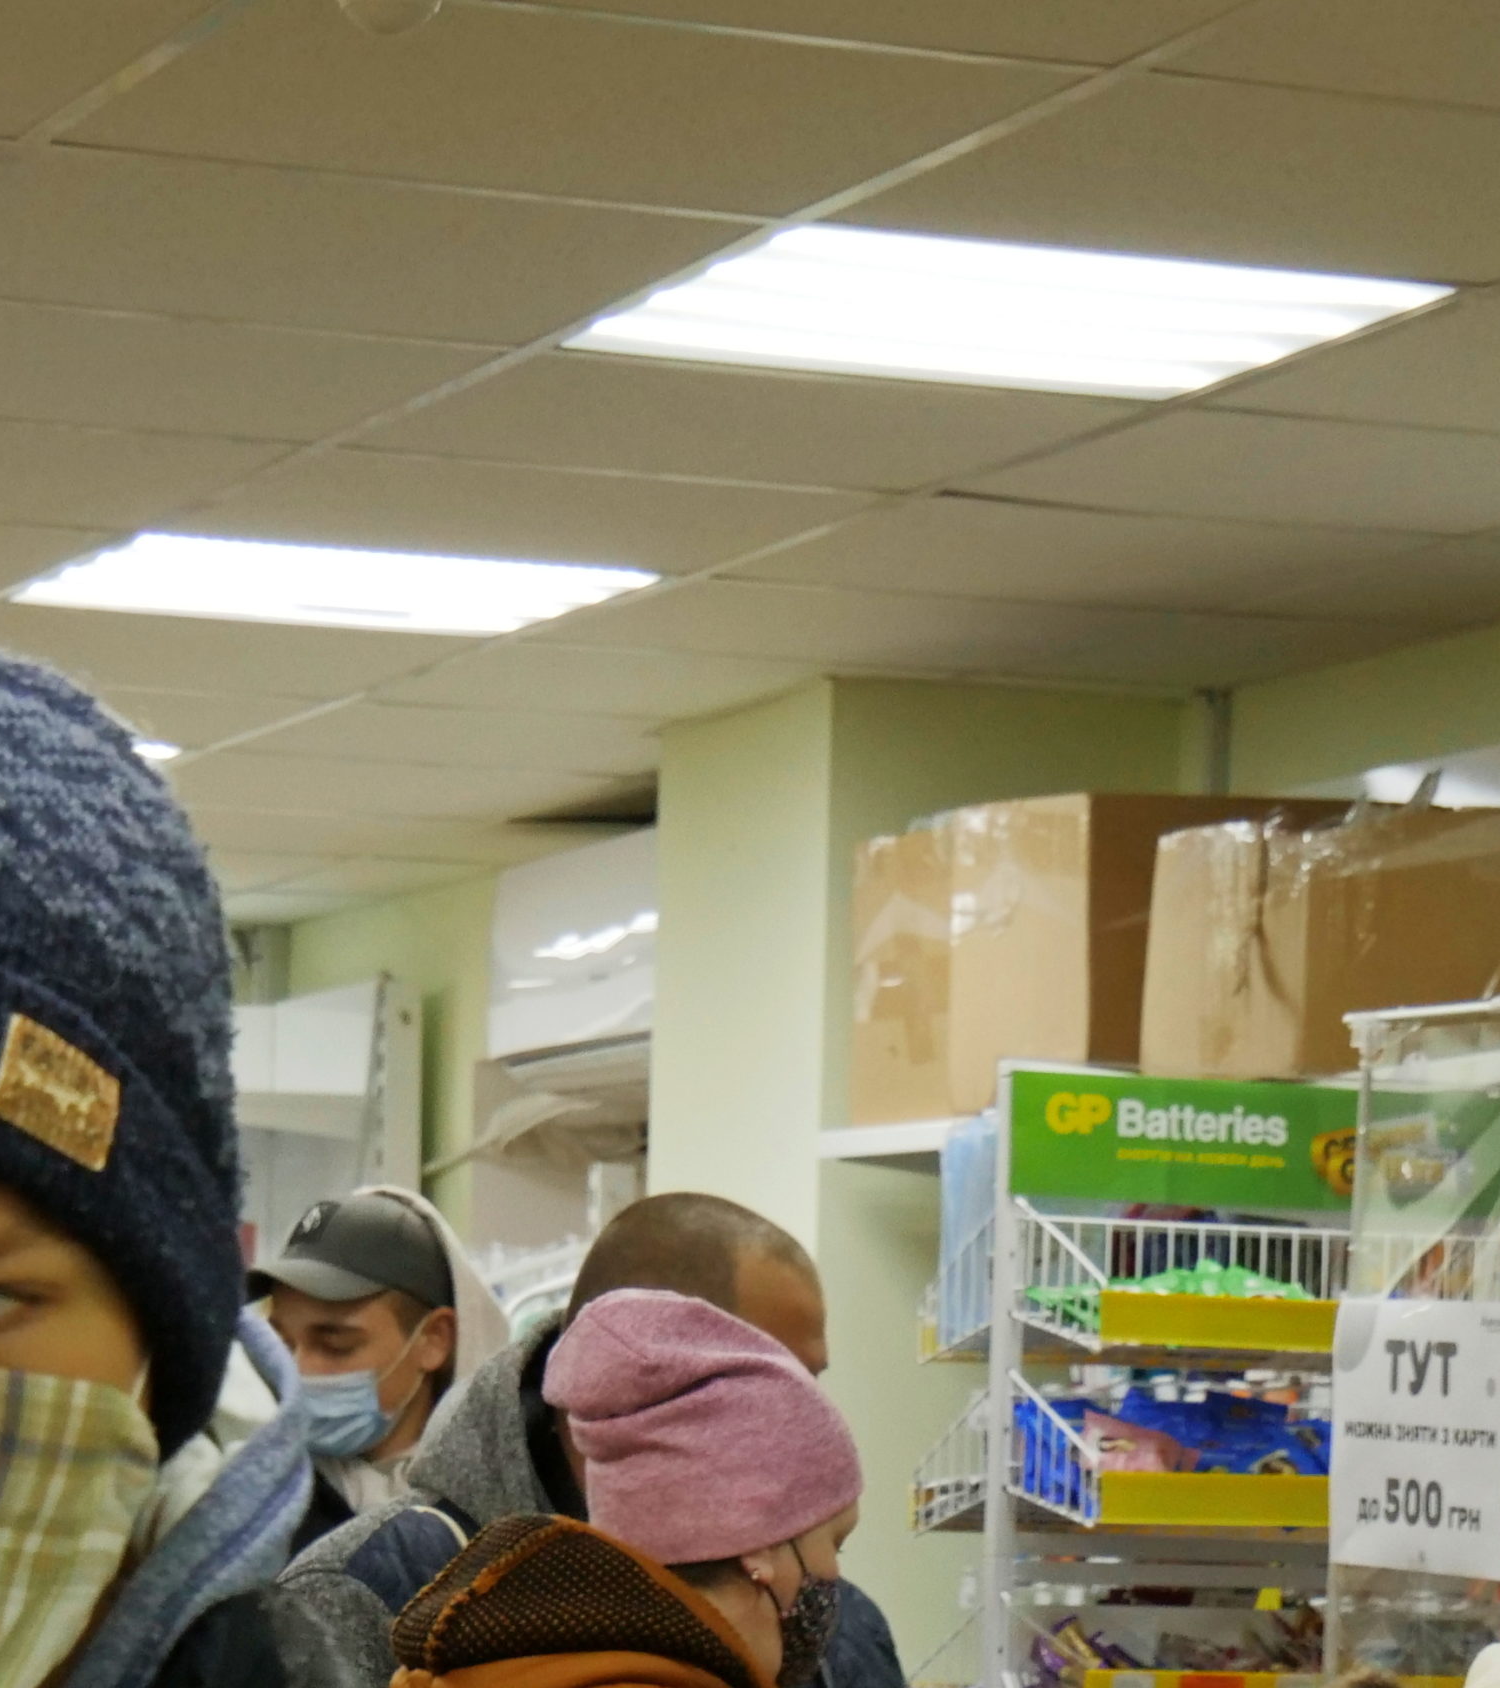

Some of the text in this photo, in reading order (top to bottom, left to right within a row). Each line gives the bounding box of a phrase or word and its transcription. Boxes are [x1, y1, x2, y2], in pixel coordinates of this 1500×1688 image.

[1046, 1092, 1289, 1148] GP Batteries
[1384, 1338, 1458, 1398] ТУТ
[1384, 1477, 1443, 1528] 500
